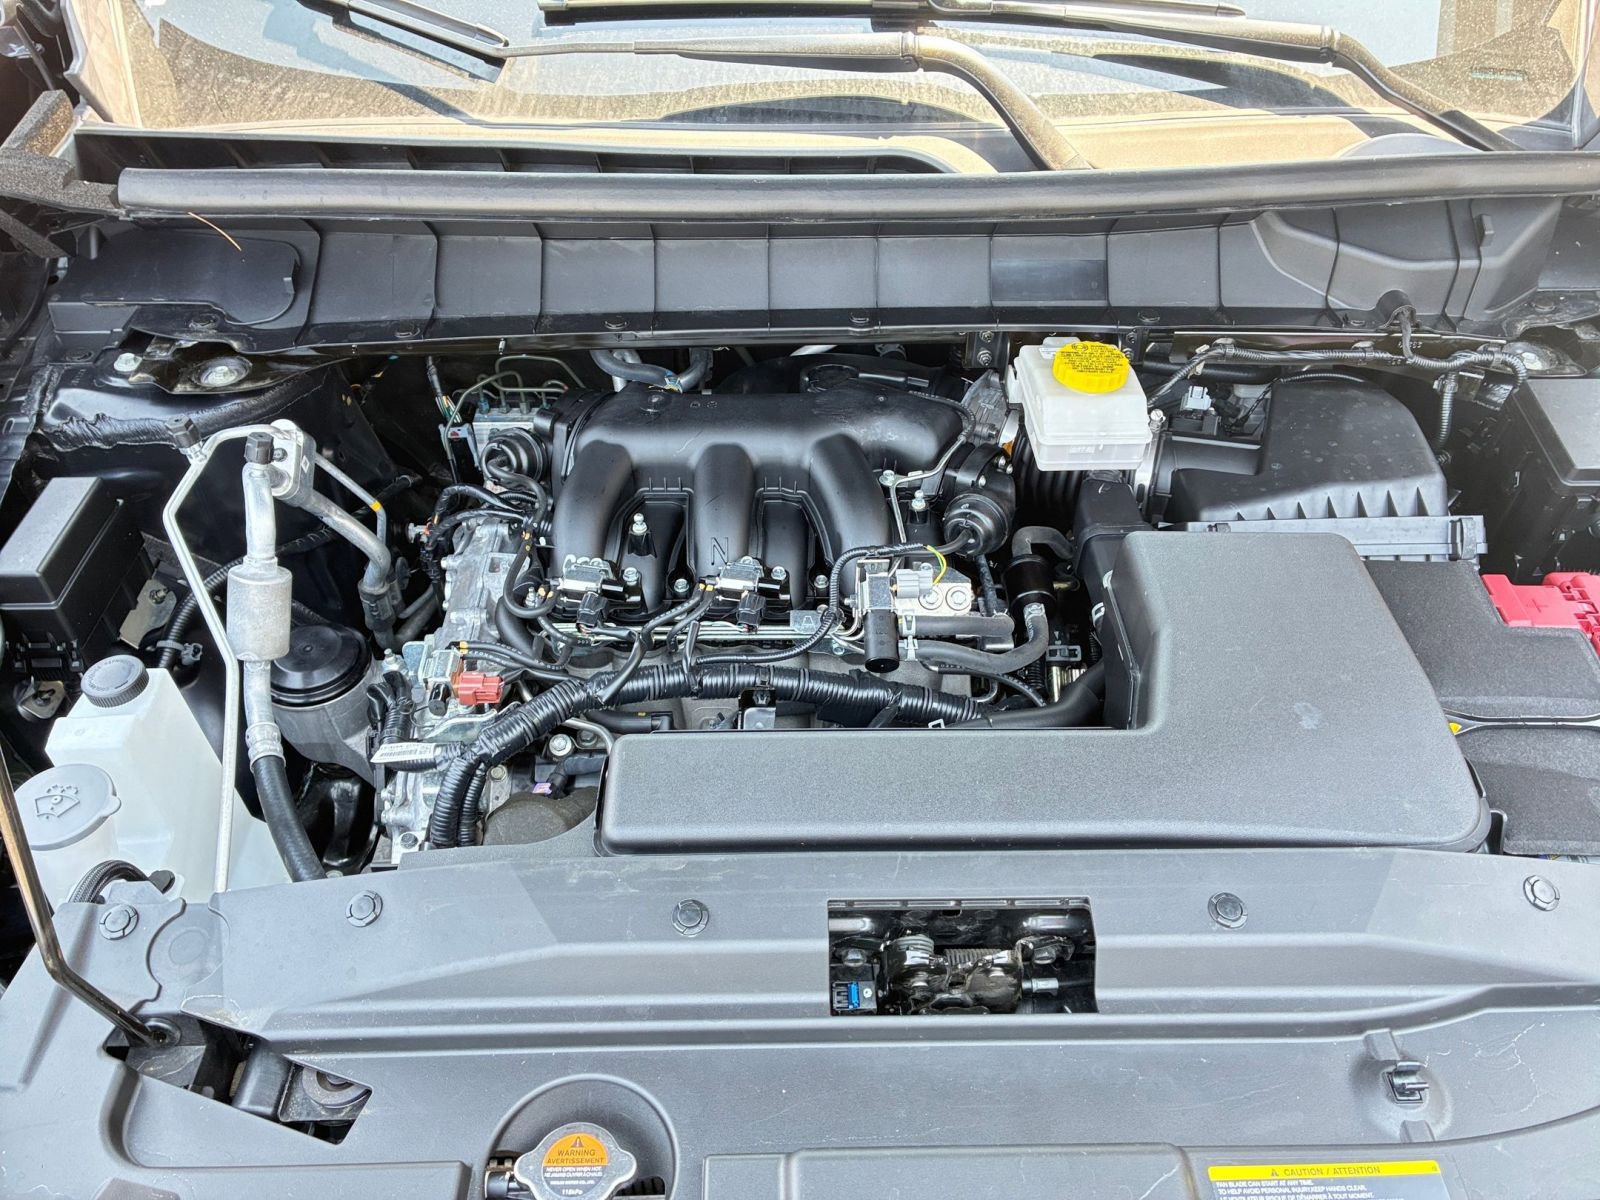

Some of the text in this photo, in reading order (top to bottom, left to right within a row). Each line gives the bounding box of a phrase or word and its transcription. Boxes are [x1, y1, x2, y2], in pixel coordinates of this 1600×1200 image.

[557, 1149, 596, 1157] WARNING
[1283, 1168, 1324, 1177] CAUTION
[1333, 1166, 1381, 1176] ATTENTION
